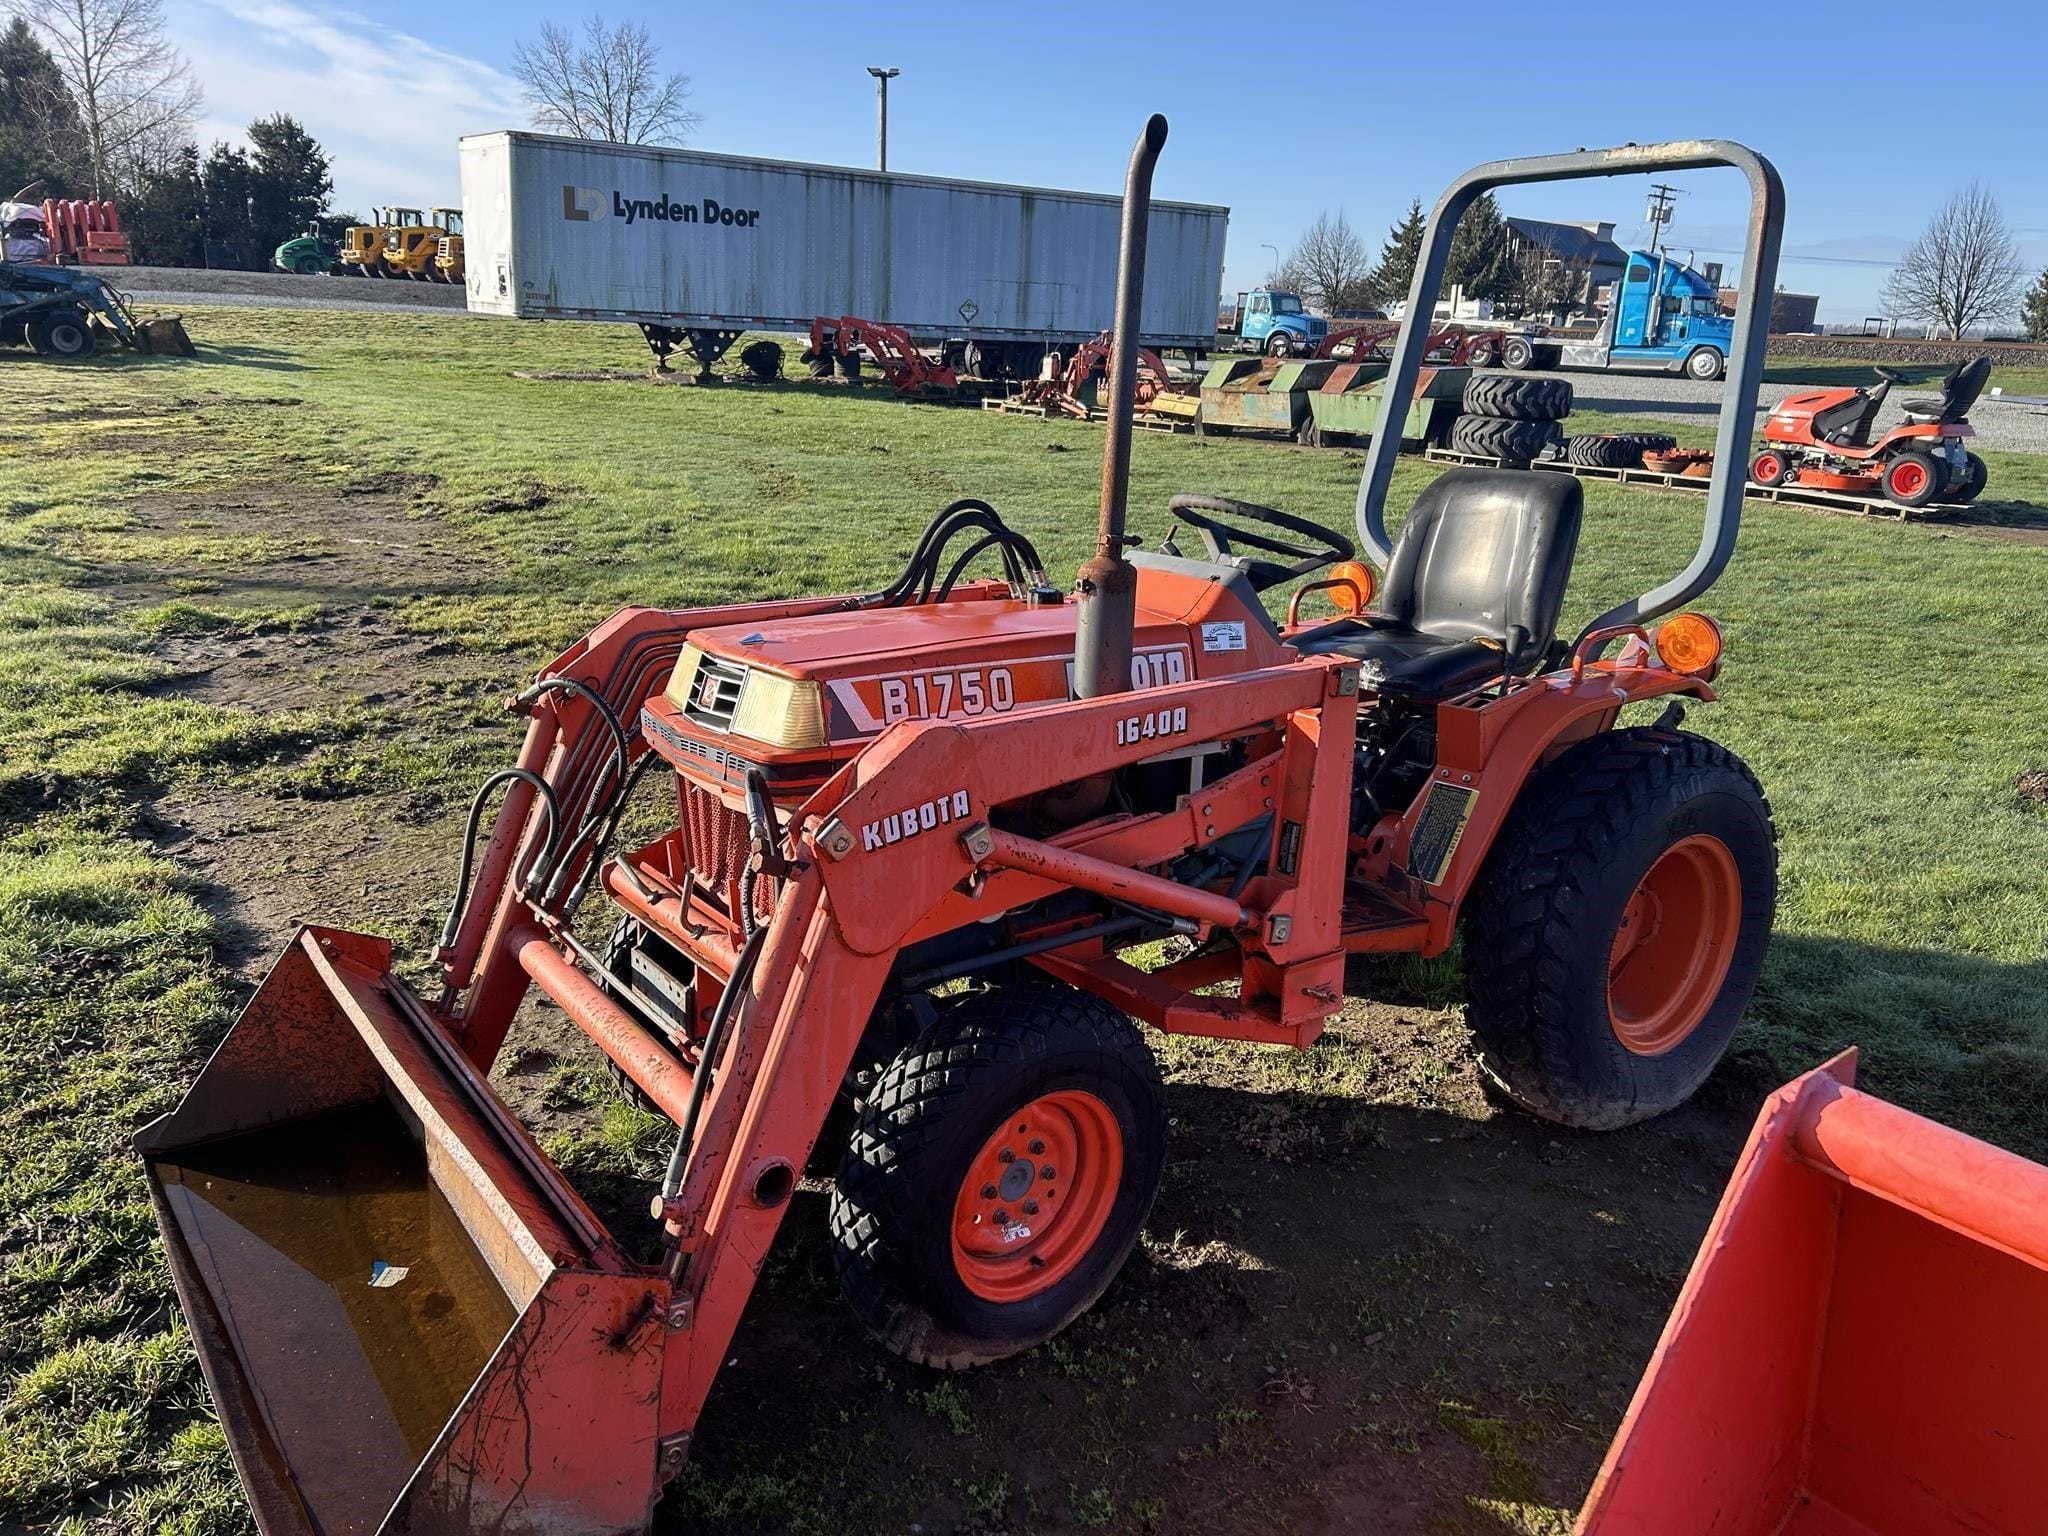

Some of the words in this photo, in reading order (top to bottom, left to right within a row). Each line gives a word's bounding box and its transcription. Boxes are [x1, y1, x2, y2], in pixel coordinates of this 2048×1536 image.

[613, 190, 698, 224] Lynden
[703, 199, 760, 227] Door
[881, 667, 1016, 726] B1750
[1116, 706, 1188, 746] 1640A
[862, 789, 971, 853] KUBOTA
[1447, 824, 1464, 855] CAUTION
[742, 904, 752, 934] TOUGH
